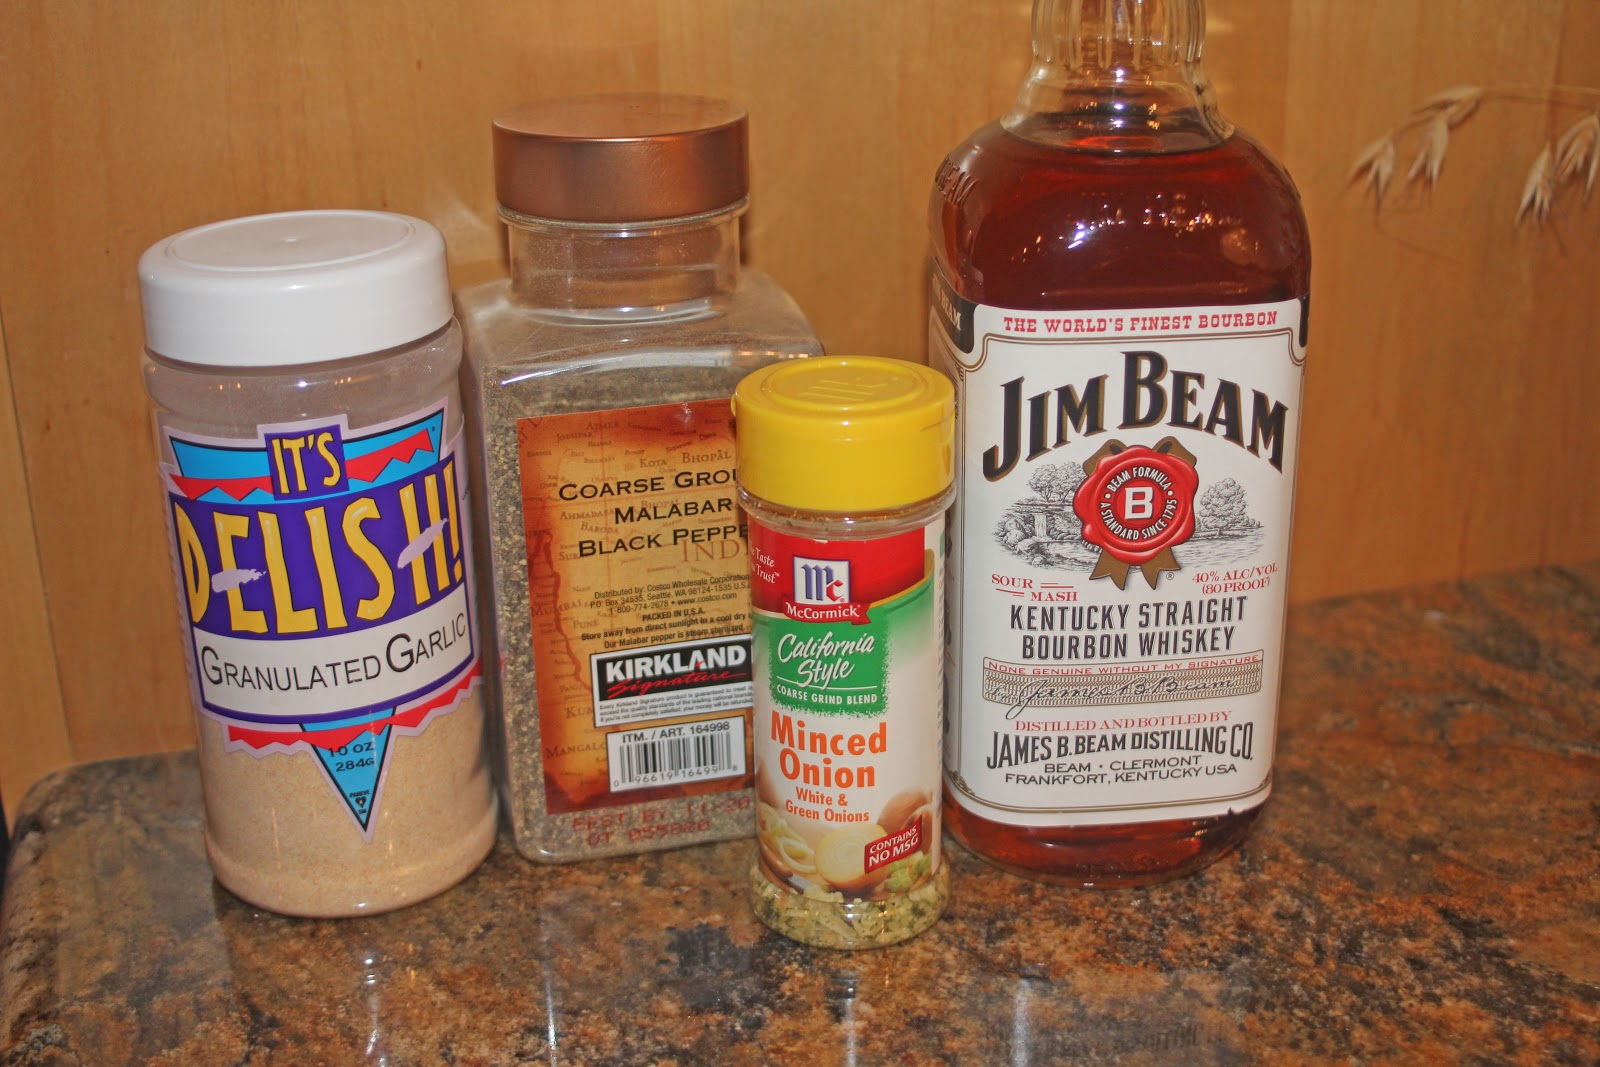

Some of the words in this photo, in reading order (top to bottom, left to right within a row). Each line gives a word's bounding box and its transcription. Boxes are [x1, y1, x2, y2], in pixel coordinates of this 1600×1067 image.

[1004, 317, 1037, 332] THE
[1044, 317, 1123, 333] WORLD'S
[1130, 315, 1192, 331] FINEST
[1198, 311, 1278, 328] BOURBON
[983, 373, 1109, 481] JIM
[1117, 350, 1290, 474] BEAM
[271, 431, 342, 496] IT'S
[559, 476, 665, 501] COARSE
[1107, 469, 1131, 493] BEAM
[1132, 466, 1172, 491] FORMULA
[614, 497, 733, 524] MALABAR
[1124, 486, 1153, 520] B
[1101, 509, 1139, 540] STANDARD
[1142, 518, 1167, 540] SINCE
[1163, 499, 1178, 520] 1795
[173, 461, 464, 635] DELISH!
[578, 534, 663, 558] BLACK
[755, 547, 775, 567] Taste
[991, 573, 1033, 589] SOUR
[1192, 571, 1220, 584] 40%
[1222, 564, 1278, 581] ALC/VOL
[1202, 584, 1220, 596] (80
[1222, 576, 1271, 594] PROOF)
[594, 587, 633, 599] Distributed
[647, 582, 671, 592] Costco
[672, 578, 708, 589] Wholesale
[605, 598, 618, 607] Box
[674, 589, 687, 597] WA
[688, 583, 732, 596] 98124-1535
[1030, 591, 1078, 602] MASH
[609, 600, 669, 615] 1-800-774-2678
[642, 611, 671, 622] PACKED
[673, 610, 682, 618] IN
[785, 602, 860, 620] McCormick
[1010, 603, 1130, 632] KENTUCKY
[1138, 595, 1248, 629] STRAIGHT
[581, 632, 602, 641] Store
[603, 628, 624, 638] away
[625, 626, 643, 634] from
[645, 622, 667, 632] direct
[668, 617, 699, 628] sunlight
[716, 613, 732, 622] cool
[733, 612, 746, 621] dry
[201, 645, 381, 692] GRANULATED
[385, 612, 467, 673] GARLIC
[604, 640, 617, 649] Our
[618, 636, 649, 647] Malabar
[650, 632, 676, 643] pepper
[777, 631, 876, 663] California
[1022, 631, 1128, 661] BOURBON
[1138, 625, 1235, 657] WHISKEY
[606, 645, 747, 683] KIRKLAND
[797, 658, 855, 691] Style
[988, 661, 1025, 675] NONE
[1032, 667, 1093, 676] GENUINE
[1098, 663, 1159, 674] WITHOUT
[1164, 662, 1182, 670] MY
[1188, 654, 1260, 669] SIGNATURE
[607, 670, 747, 700] Signature
[776, 684, 808, 701] COARSE
[811, 693, 843, 705] GRIND
[846, 693, 878, 705] BLEND
[622, 732, 648, 743] ITM.
[659, 726, 686, 739] ART.
[690, 721, 730, 735] 164998
[771, 709, 887, 757] Minced
[1015, 720, 1096, 732] DISTILLED
[1099, 718, 1136, 730] AND
[1137, 712, 1207, 729] BOTTLED
[1209, 710, 1233, 723] BY
[352, 741, 375, 754] OZ
[986, 731, 1053, 771] JAMES
[1056, 734, 1073, 758] B.
[1075, 732, 1127, 755] BEAM
[1131, 725, 1227, 754] DISTILLING
[1229, 721, 1254, 762] CO.
[335, 757, 375, 772] 284G
[779, 747, 876, 789] Onion
[1005, 772, 1111, 786] FRANKFORT,
[1114, 766, 1203, 783] KENTUCKY
[1205, 762, 1238, 775] USA
[1044, 762, 1091, 773] BEAM
[1109, 754, 1202, 772] CLERMONT
[795, 785, 833, 806] White
[837, 793, 849, 807] &
[785, 799, 820, 820] Green
[823, 808, 870, 823] Onions
[868, 849, 891, 867] NO
[892, 835, 919, 858] MSG
[869, 825, 918, 854] CONTAINS
